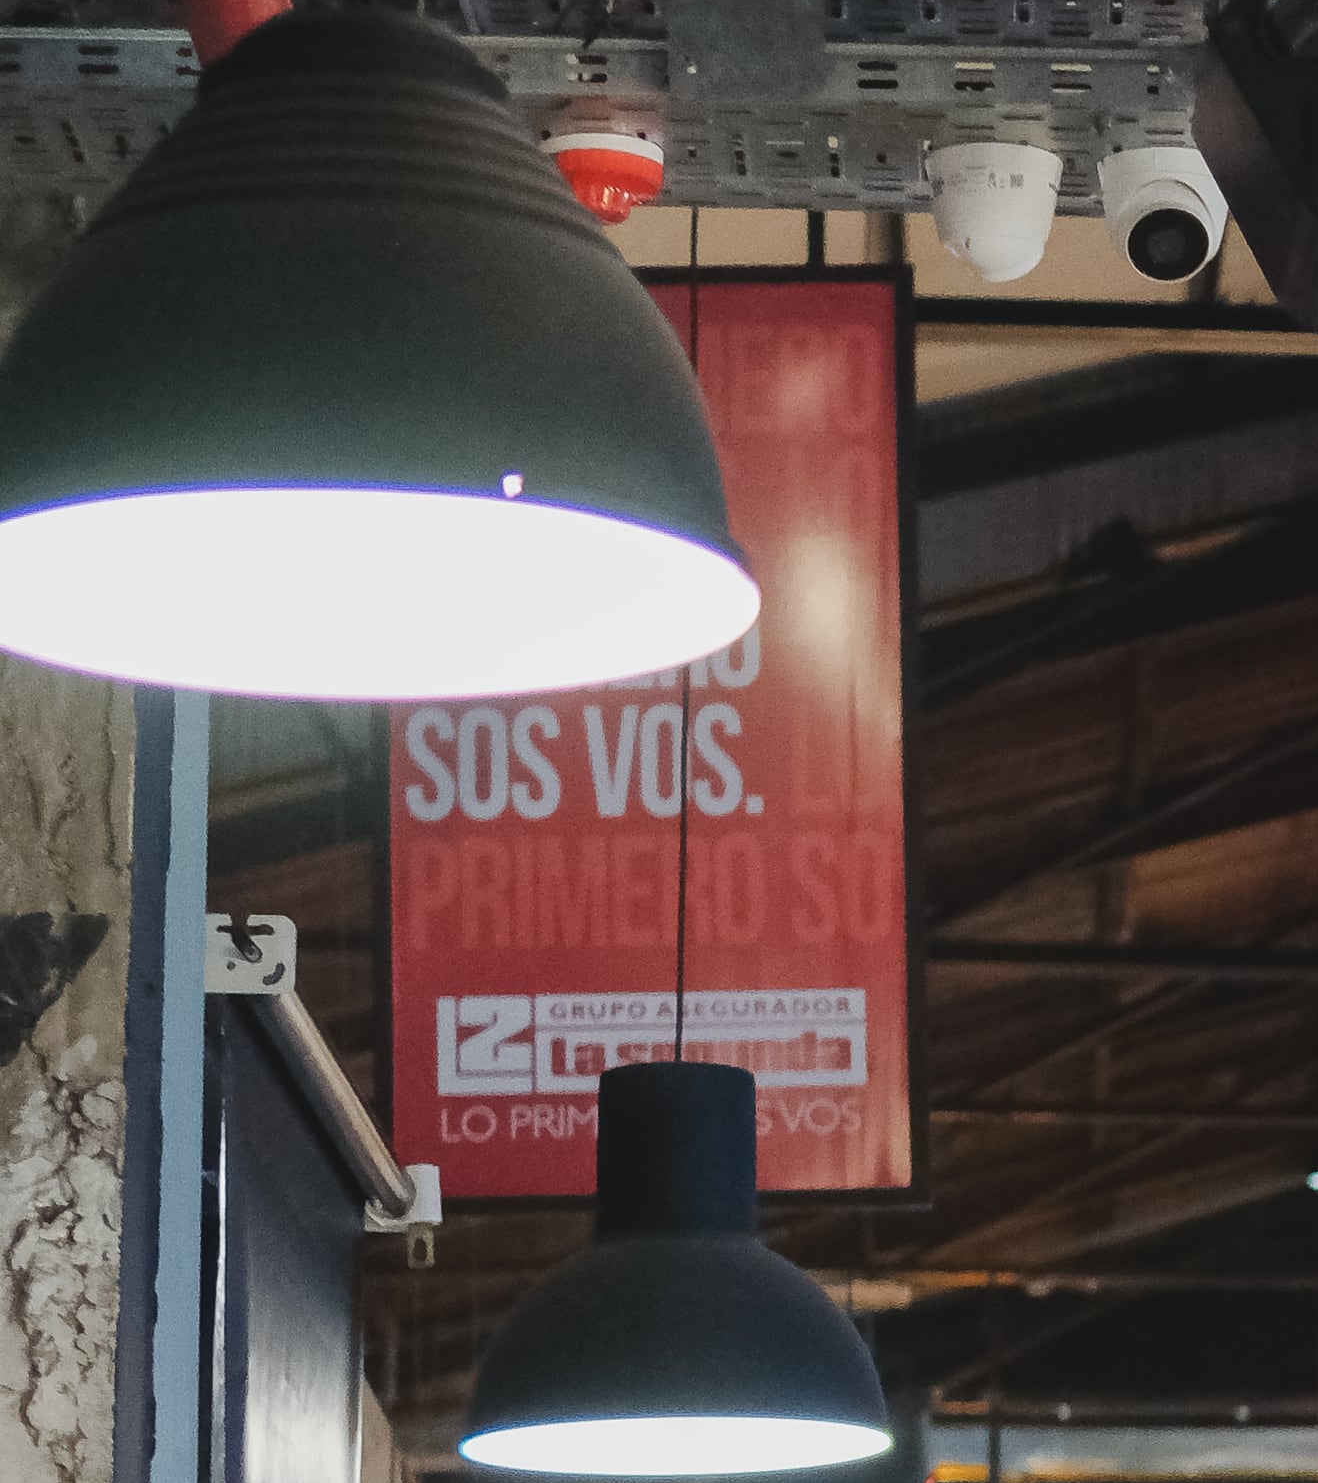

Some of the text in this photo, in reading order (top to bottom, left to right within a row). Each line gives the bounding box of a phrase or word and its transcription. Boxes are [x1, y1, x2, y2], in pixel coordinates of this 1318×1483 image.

[405, 706, 561, 822] SOS
[584, 702, 765, 818] VOS.
[407, 832, 765, 949] PRIMERO
[549, 1001, 647, 1020] GRUPO
[440, 1102, 600, 1143] LO PRIM
[774, 1097, 862, 1137] VOS
